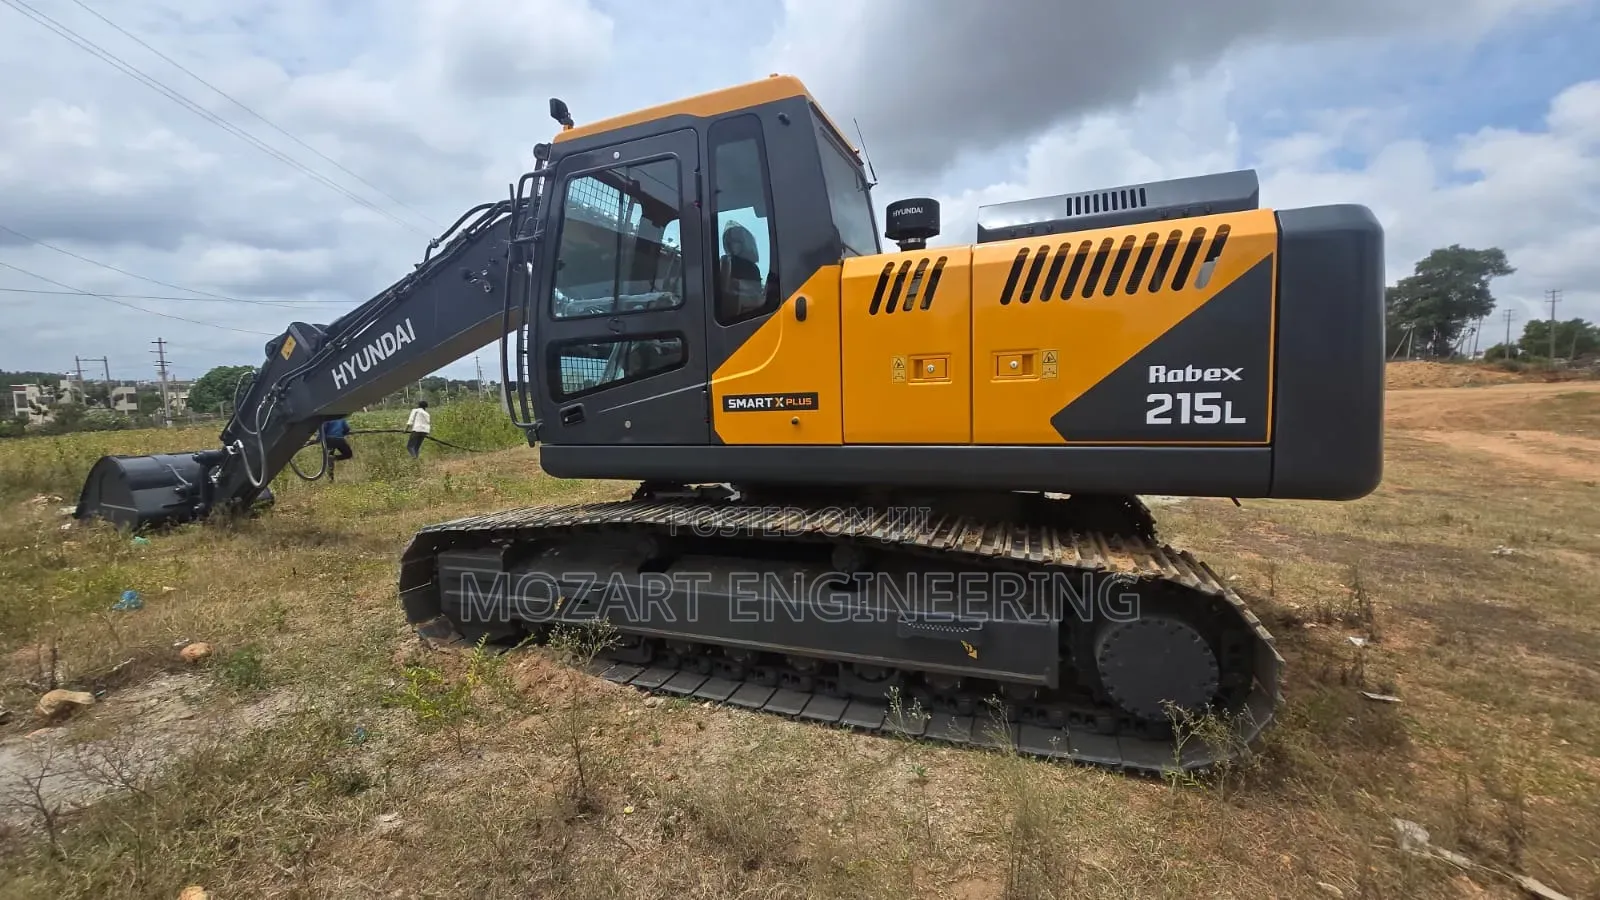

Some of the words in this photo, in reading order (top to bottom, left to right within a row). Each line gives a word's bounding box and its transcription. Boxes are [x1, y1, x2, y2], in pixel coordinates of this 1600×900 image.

[893, 207, 924, 217] HYUNDAI
[331, 318, 416, 390] HYUNDAI
[1148, 364, 1244, 383] Robex
[728, 398, 773, 409] SMART
[786, 397, 812, 406] PLUS
[1146, 392, 1246, 425] 215L
